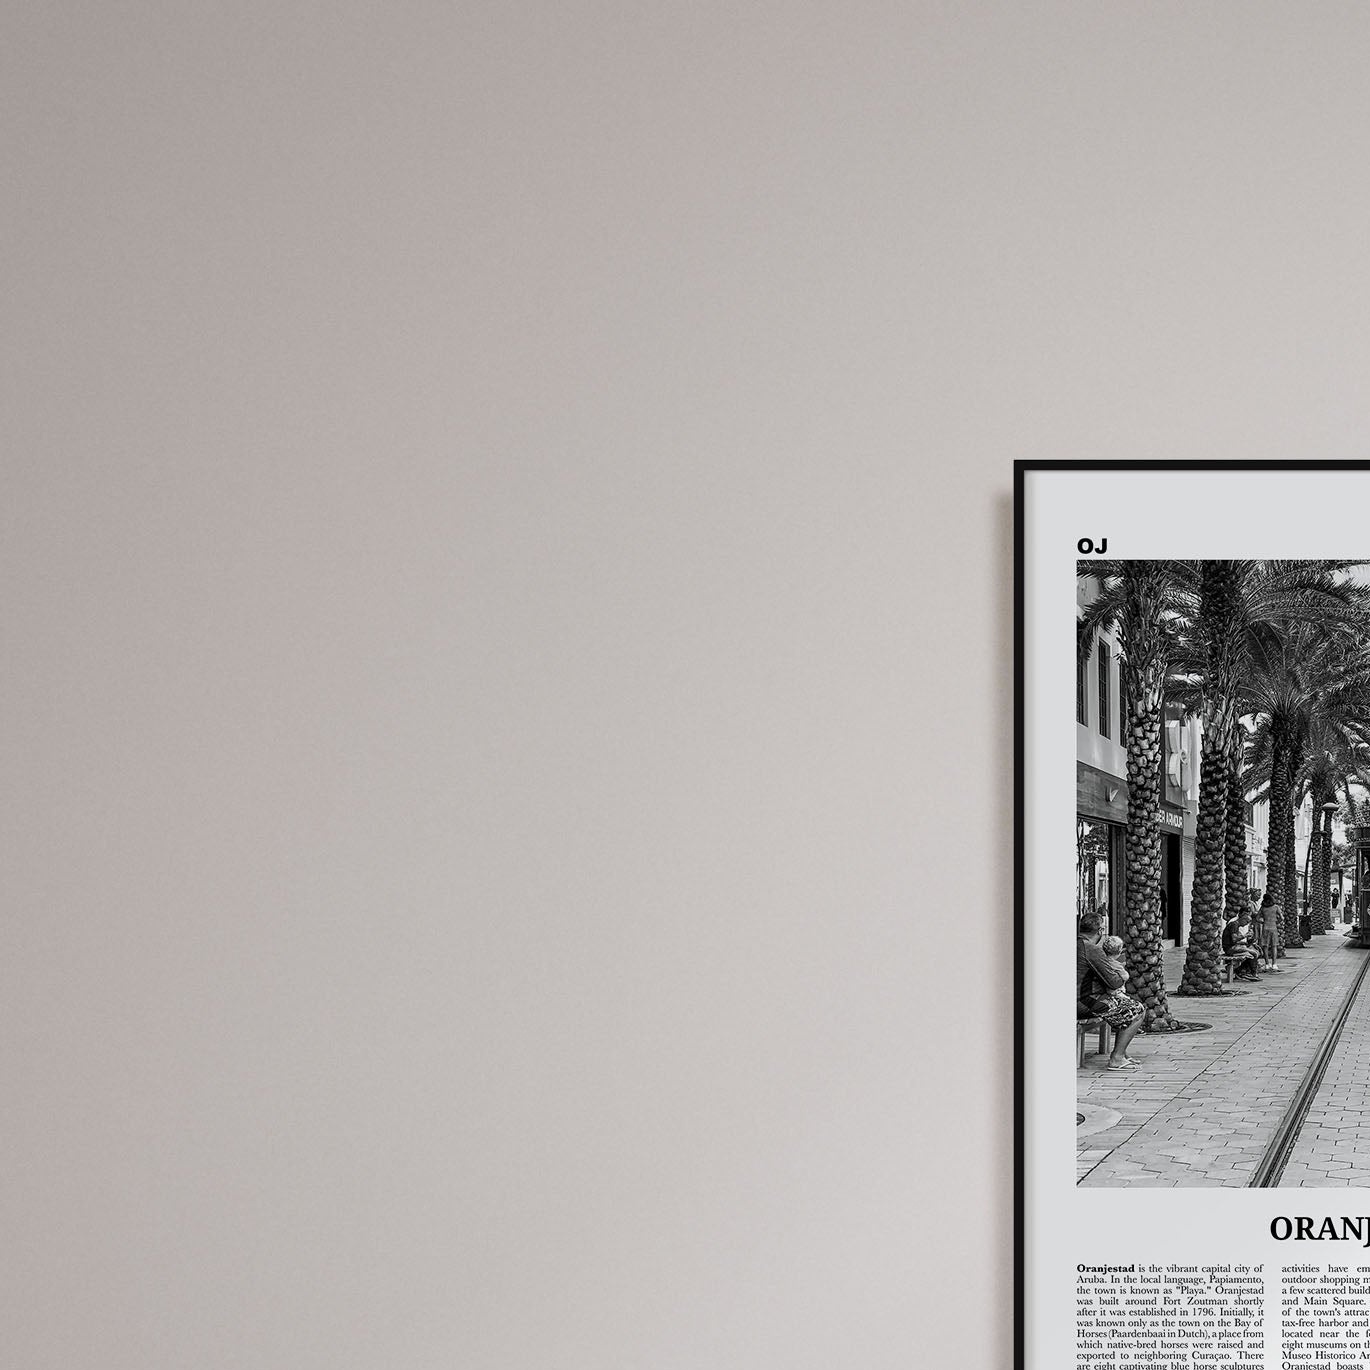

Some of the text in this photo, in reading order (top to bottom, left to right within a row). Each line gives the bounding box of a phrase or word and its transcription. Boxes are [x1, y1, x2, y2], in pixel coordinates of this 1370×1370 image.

[1077, 538, 1107, 554] OJ
[1076, 1264, 1264, 1274] Oranjestad is the vibrant capital city of
[1281, 1264, 1320, 1273] activities
[1328, 1264, 1349, 1273] have
[1076, 1275, 1264, 1285] Aruba. In the local language, Papiamento,
[1076, 1286, 1091, 1294] the
[1094, 1286, 1116, 1294] town
[1119, 1286, 1127, 1294] is
[1130, 1286, 1160, 1294] known
[1176, 1286, 1212, 1296] "Playa."
[1215, 1286, 1264, 1296] Oranjestad
[1289, 1286, 1306, 1294] few
[1307, 1286, 1346, 1294] scattered
[1076, 1308, 1097, 1316] after
[1100, 1308, 1106, 1316] it
[1128, 1308, 1177, 1316] established
[1179, 1308, 1189, 1316] in
[1193, 1308, 1216, 1316] 1796.
[1220, 1308, 1255, 1318] Initially,
[1258, 1308, 1264, 1316] it
[1281, 1308, 1292, 1316] of
[1295, 1308, 1310, 1316] the
[1313, 1308, 1341, 1316] town's
[1077, 1329, 1108, 1338] Horses
[1108, 1329, 1166, 1340] (Paardenbaai
[1167, 1329, 1176, 1338] in
[1177, 1329, 1210, 1340] Dutch),
[1218, 1329, 1242, 1340] place
[1243, 1329, 1264, 1338] from
[1281, 1329, 1314, 1338] located
[1345, 1329, 1360, 1338] the
[1076, 1351, 1264, 1361] exported to neighboring Curaçao. There
[1281, 1351, 1312, 1359] Museo
[1315, 1351, 1356, 1359] Historico
